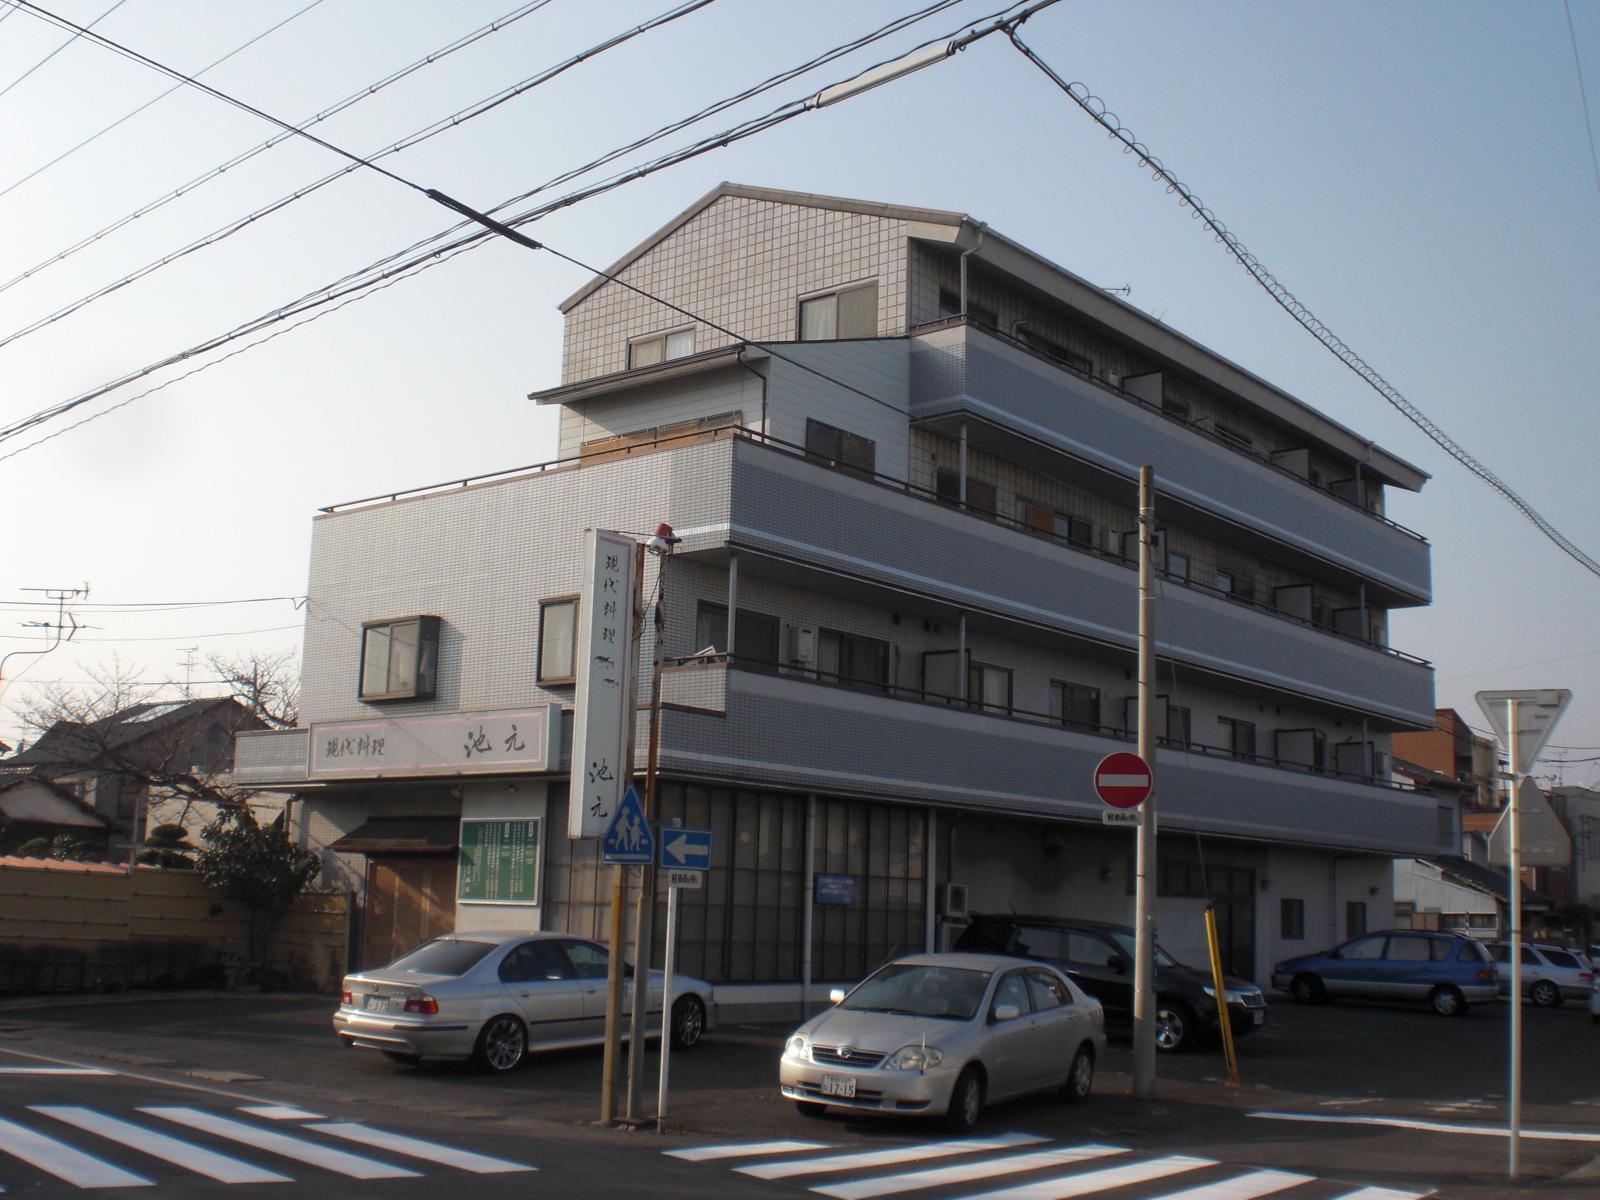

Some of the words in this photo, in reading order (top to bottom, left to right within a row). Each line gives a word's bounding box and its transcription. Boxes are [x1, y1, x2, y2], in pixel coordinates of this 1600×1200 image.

[603, 554, 620, 643] 現代料理
[325, 734, 385, 758] 現代料理
[587, 757, 614, 818] 池元
